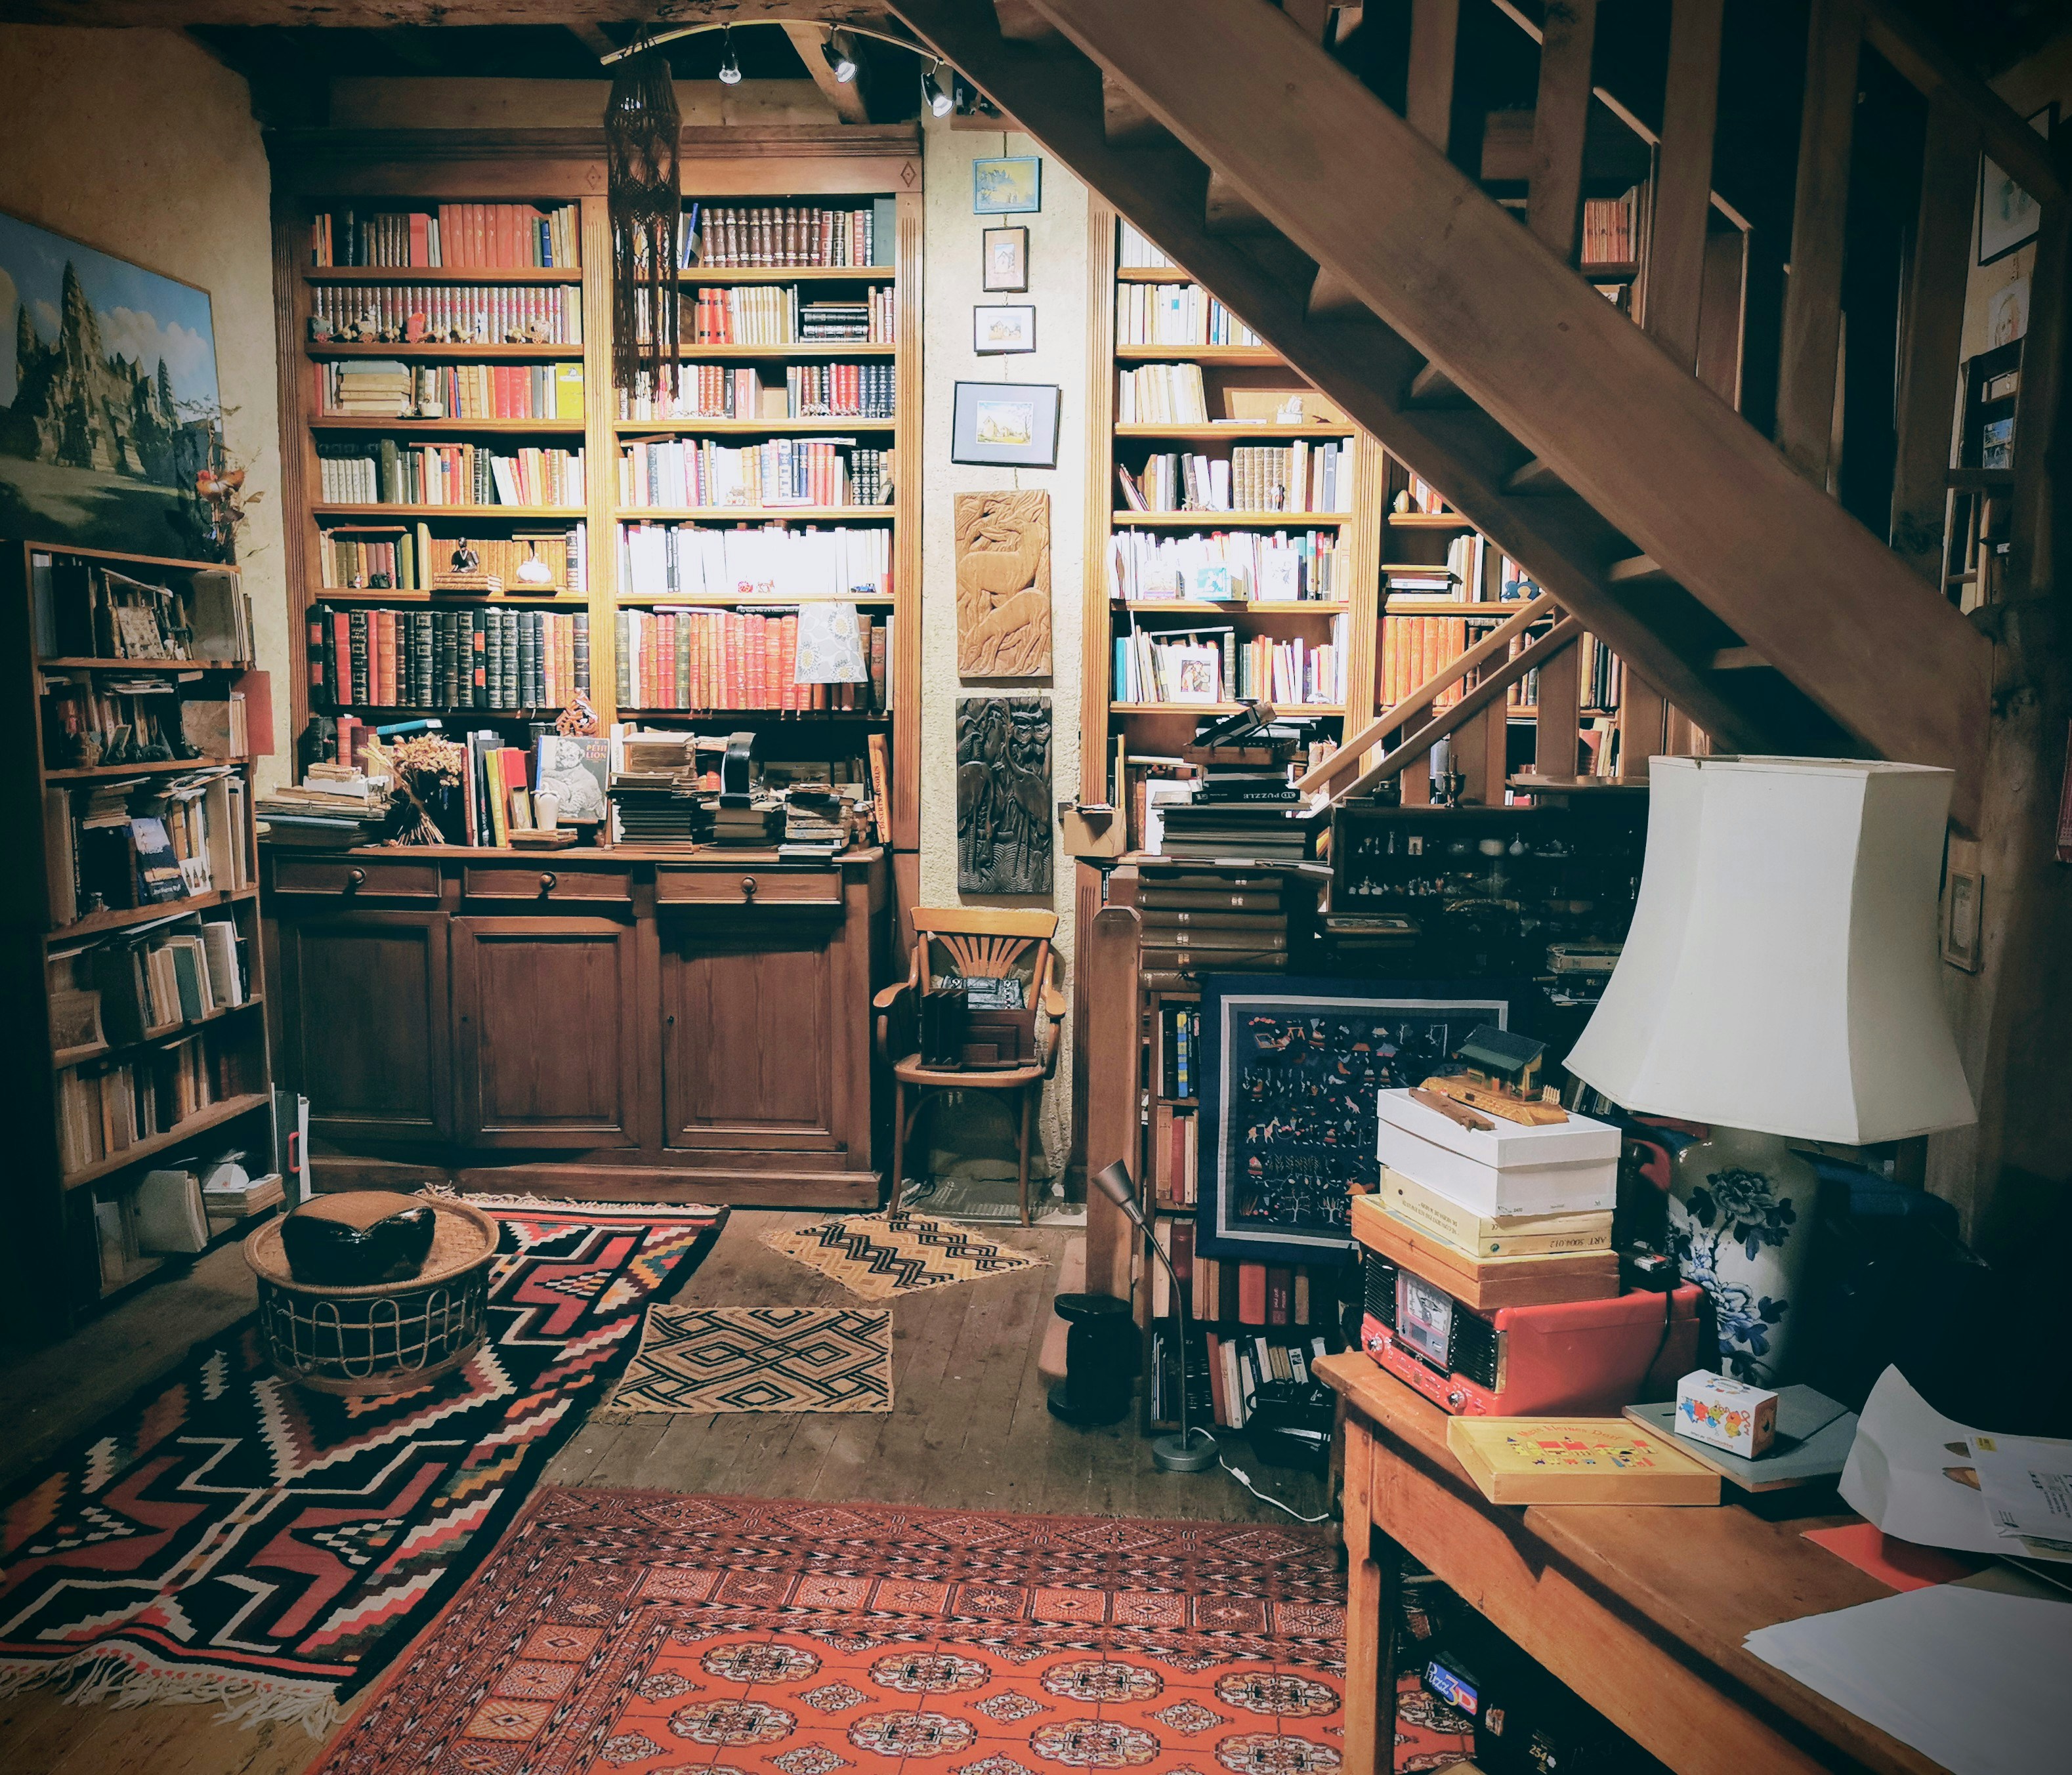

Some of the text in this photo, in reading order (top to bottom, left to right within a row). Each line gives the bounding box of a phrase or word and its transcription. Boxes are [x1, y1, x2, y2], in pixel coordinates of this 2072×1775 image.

[1588, 1237, 1607, 1245] ART
[1591, 1429, 1623, 1440] Dorf
[1443, 1674, 1476, 1710] 3D
